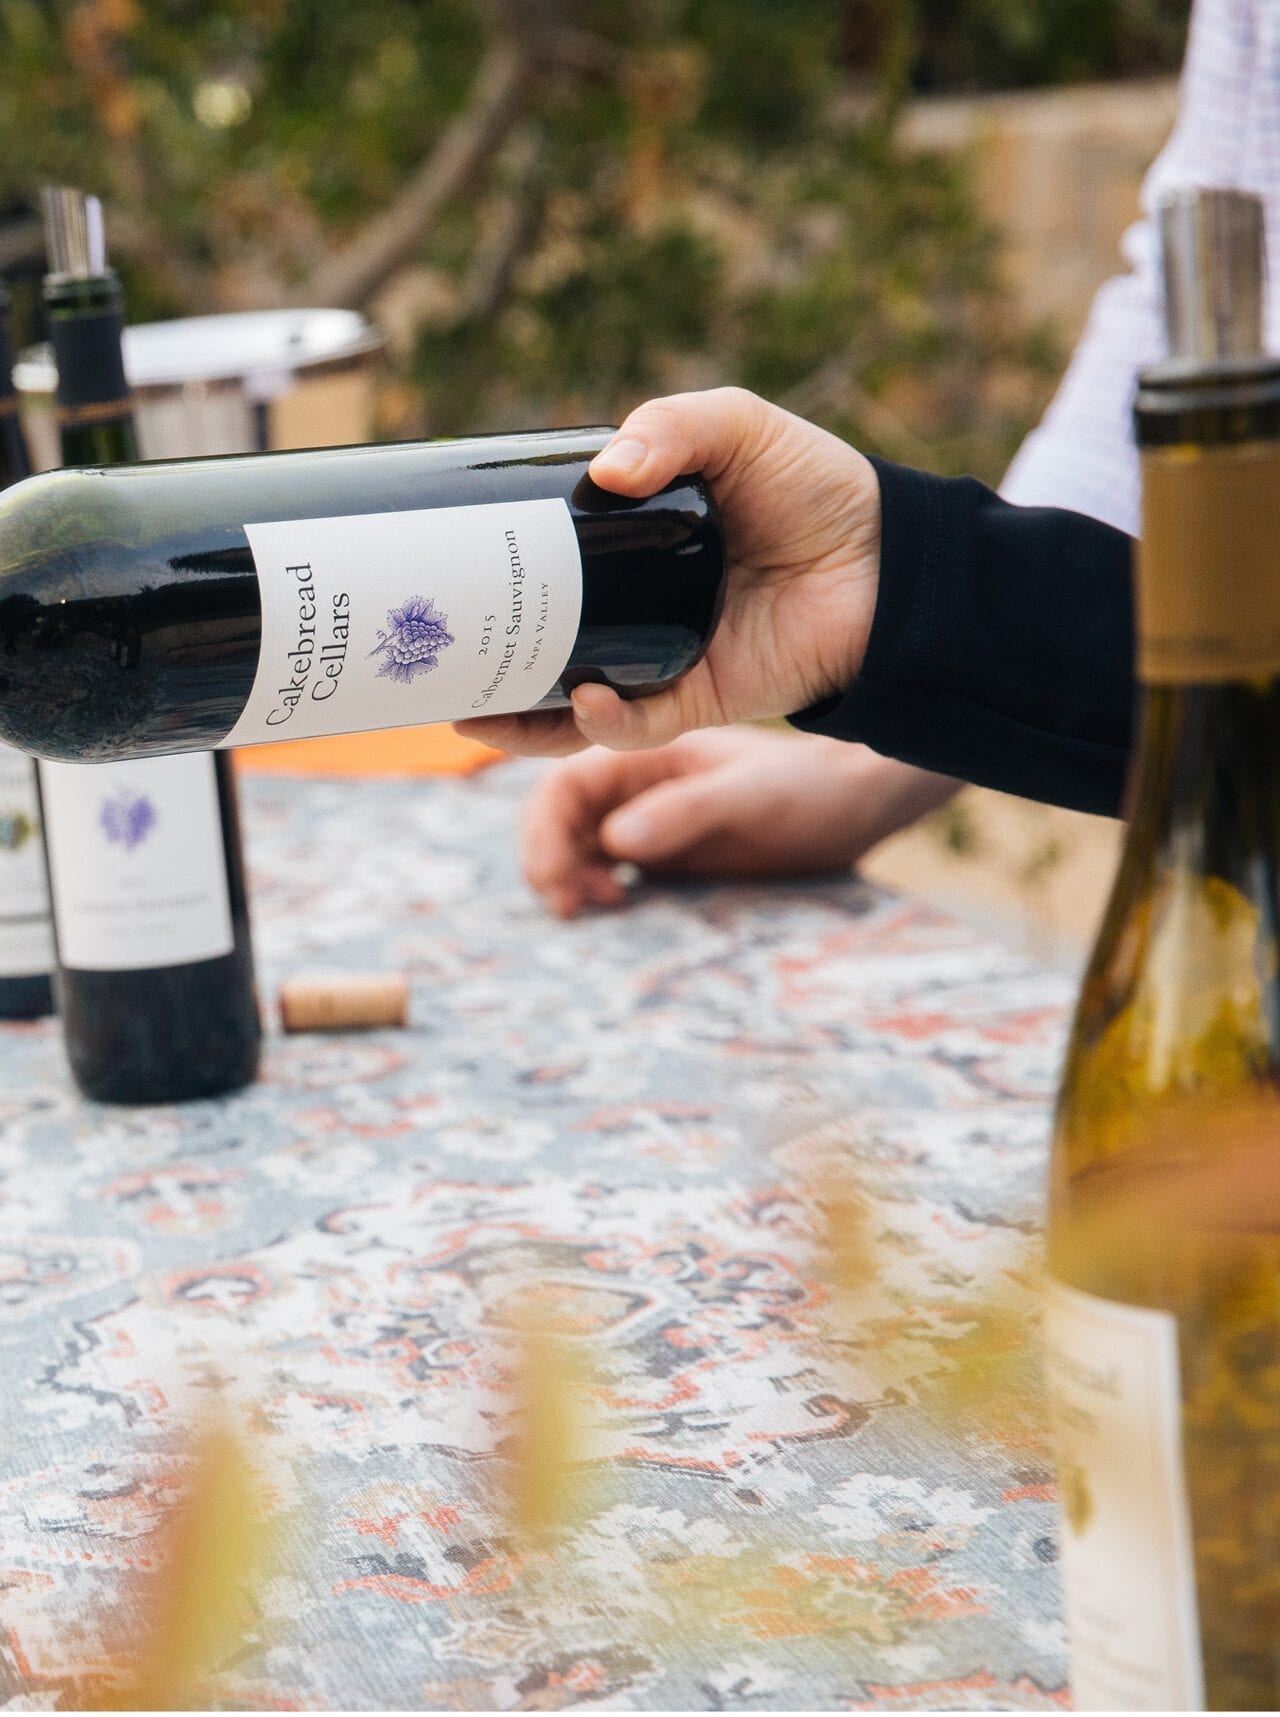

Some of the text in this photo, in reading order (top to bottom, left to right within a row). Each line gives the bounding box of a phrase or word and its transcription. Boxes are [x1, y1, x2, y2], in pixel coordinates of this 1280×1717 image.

[266, 562, 317, 726] Cakebread
[311, 592, 350, 701] Cellars
[471, 530, 526, 709] Cabernet Sauvignon
[478, 614, 496, 656] 2015
